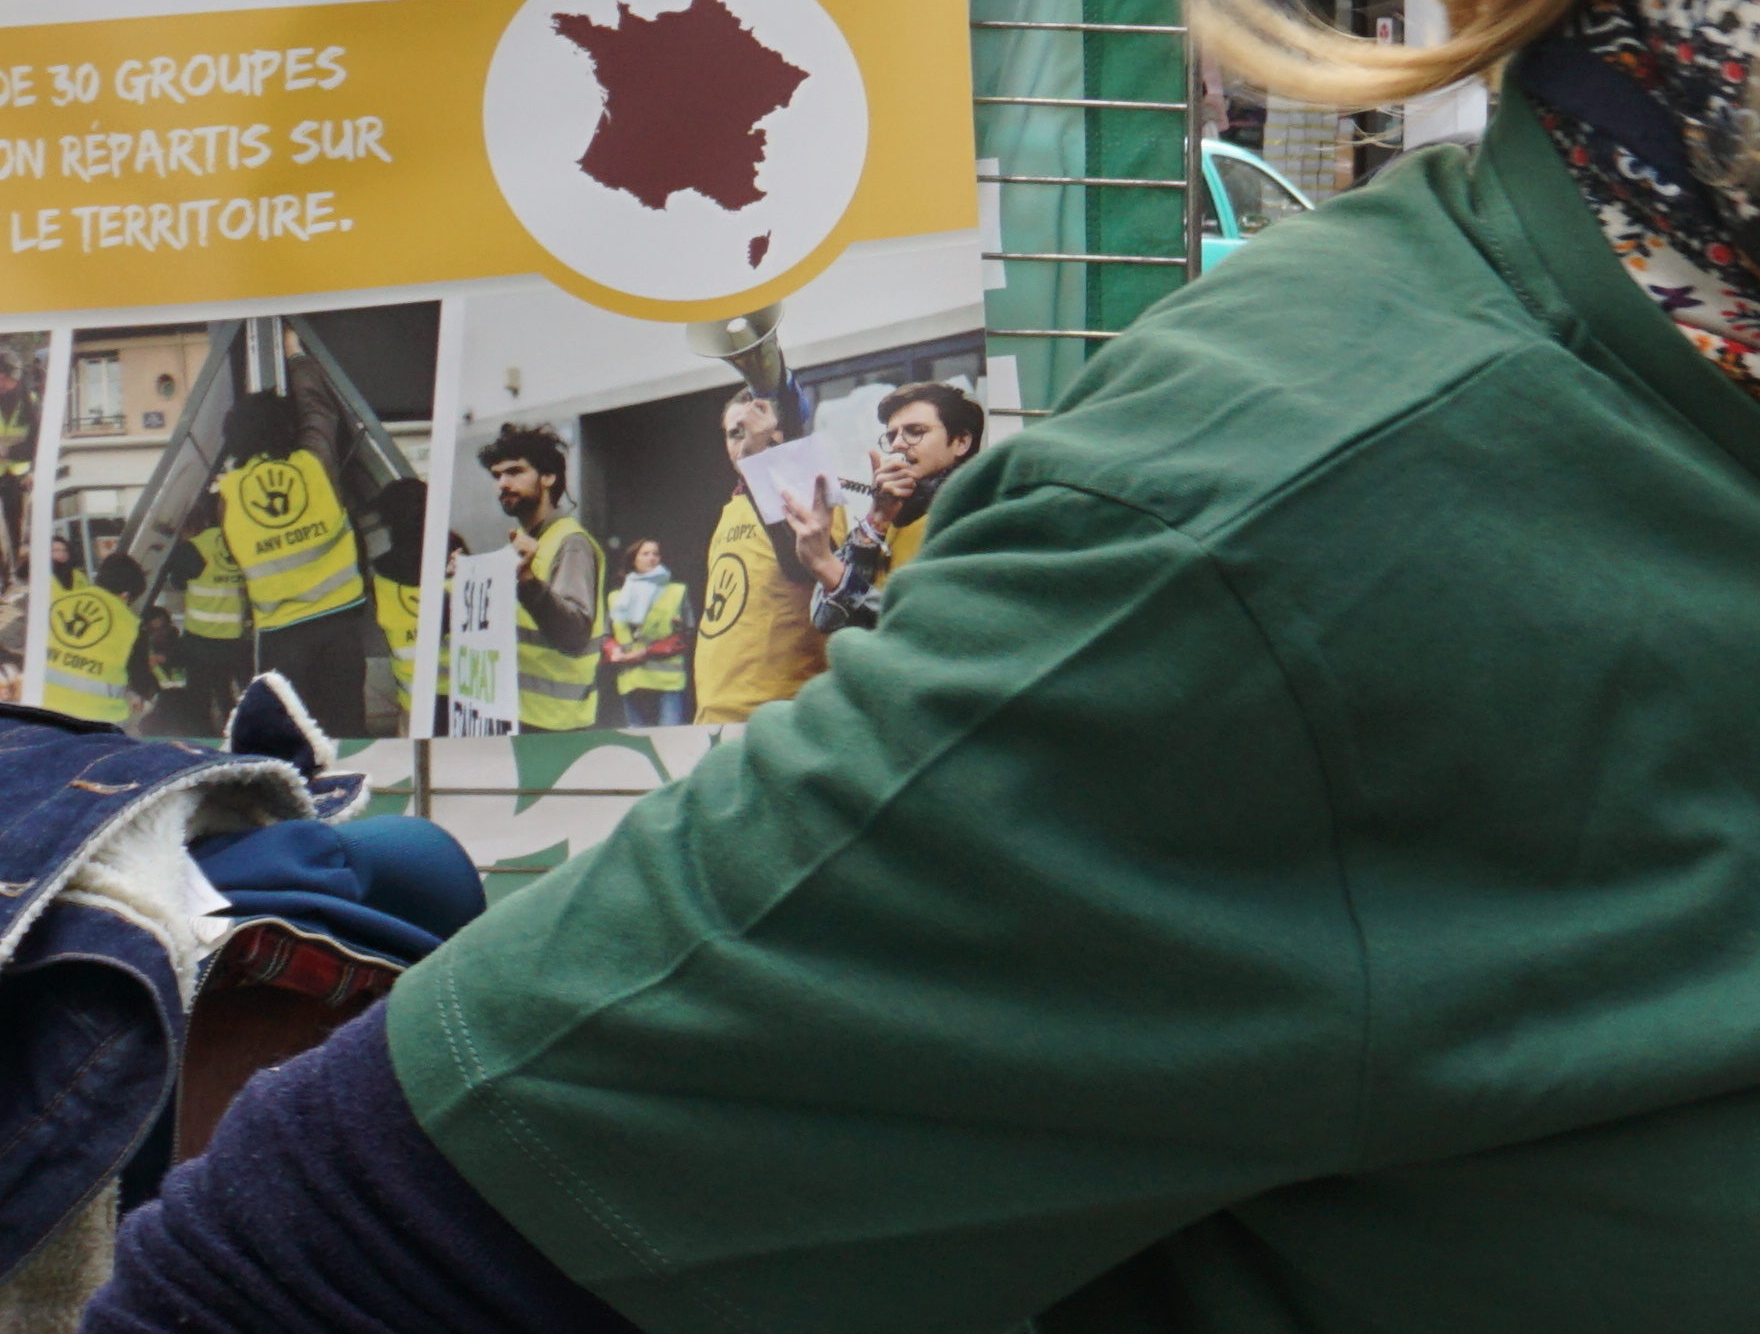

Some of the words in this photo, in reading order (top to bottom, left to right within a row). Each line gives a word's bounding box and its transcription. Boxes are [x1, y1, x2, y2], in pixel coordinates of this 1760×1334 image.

[48, 62, 99, 108] 30
[114, 45, 347, 106] GROUPES
[59, 119, 273, 183] RÉPARTIS
[290, 115, 394, 164] SUR
[10, 207, 63, 254] LE
[71, 190, 355, 254] TERRITOIRE.
[284, 521, 329, 549] COP21
